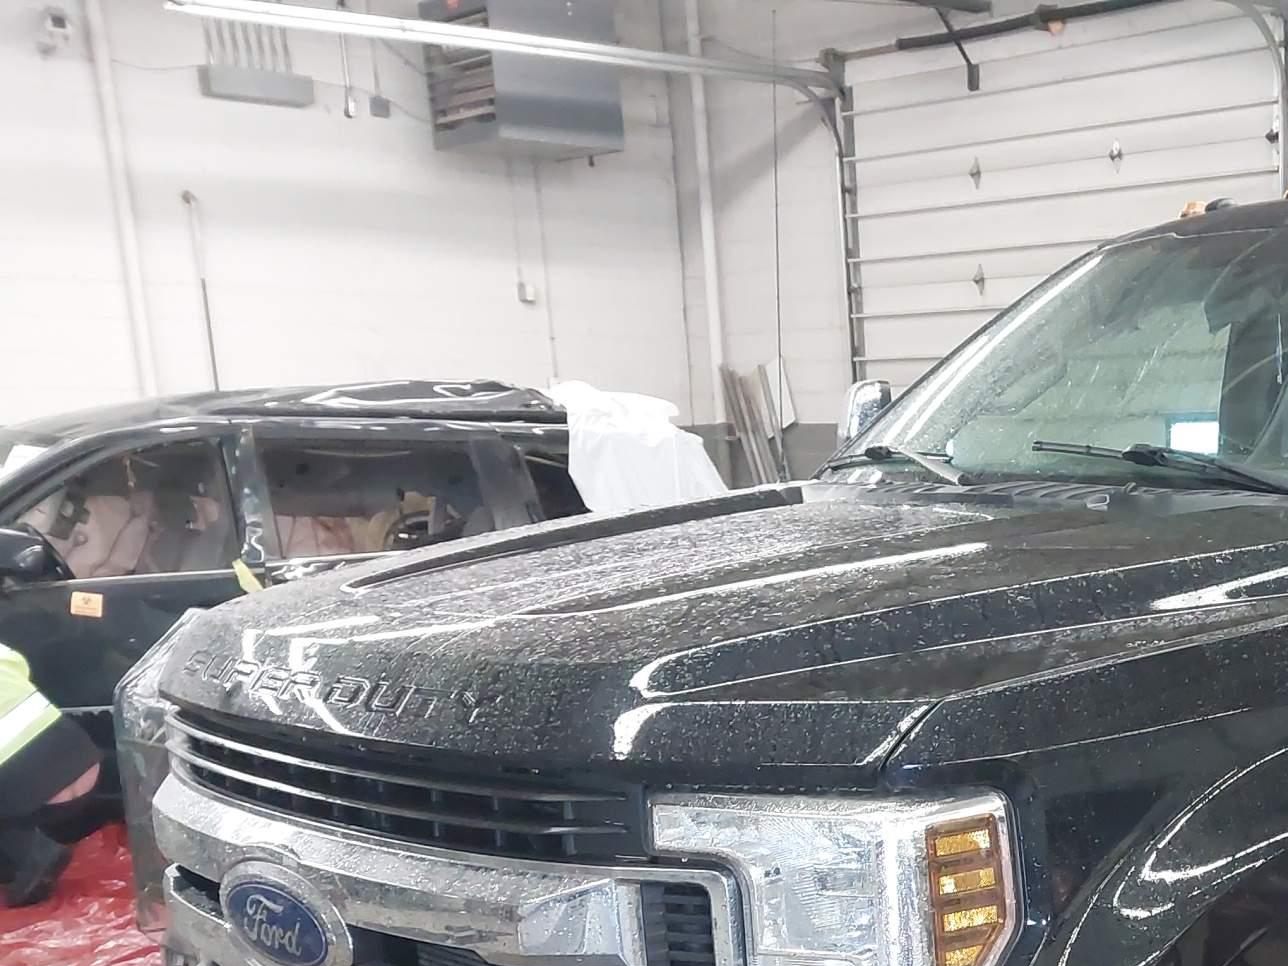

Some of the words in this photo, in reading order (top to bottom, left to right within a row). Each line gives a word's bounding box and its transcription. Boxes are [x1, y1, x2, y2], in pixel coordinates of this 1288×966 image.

[182, 651, 321, 704] SUPER
[324, 673, 504, 724] DUTY
[243, 893, 303, 957] Ford
